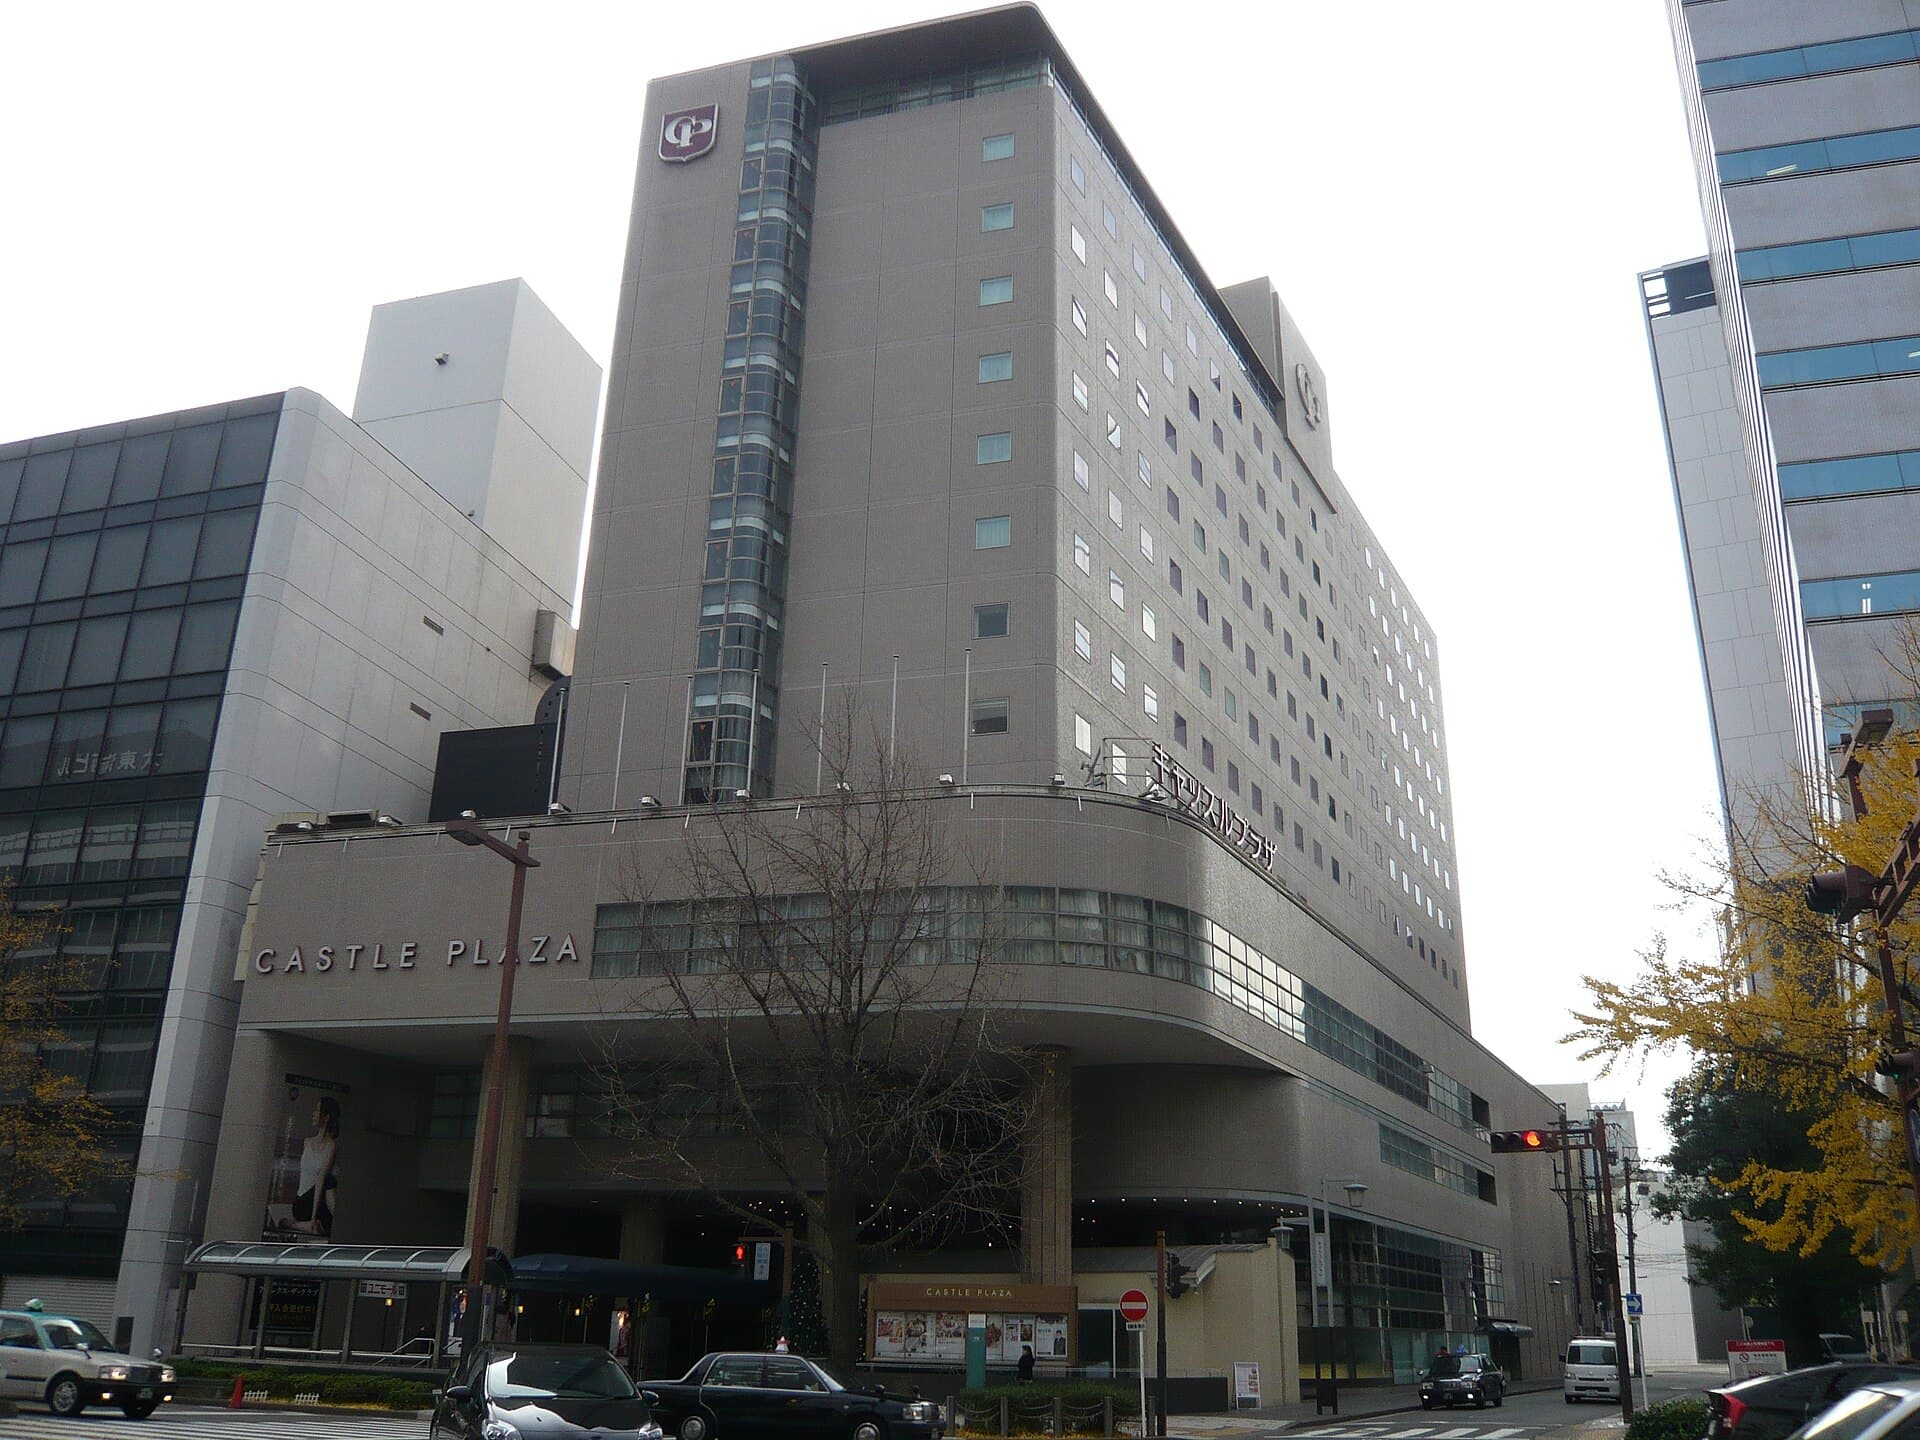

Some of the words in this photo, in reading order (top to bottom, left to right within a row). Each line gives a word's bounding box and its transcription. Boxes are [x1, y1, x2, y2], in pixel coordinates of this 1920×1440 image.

[255, 942, 417, 973] CASTLE
[926, 1288, 970, 1296] CASTLE
[977, 1288, 1012, 1297] PLAZA
